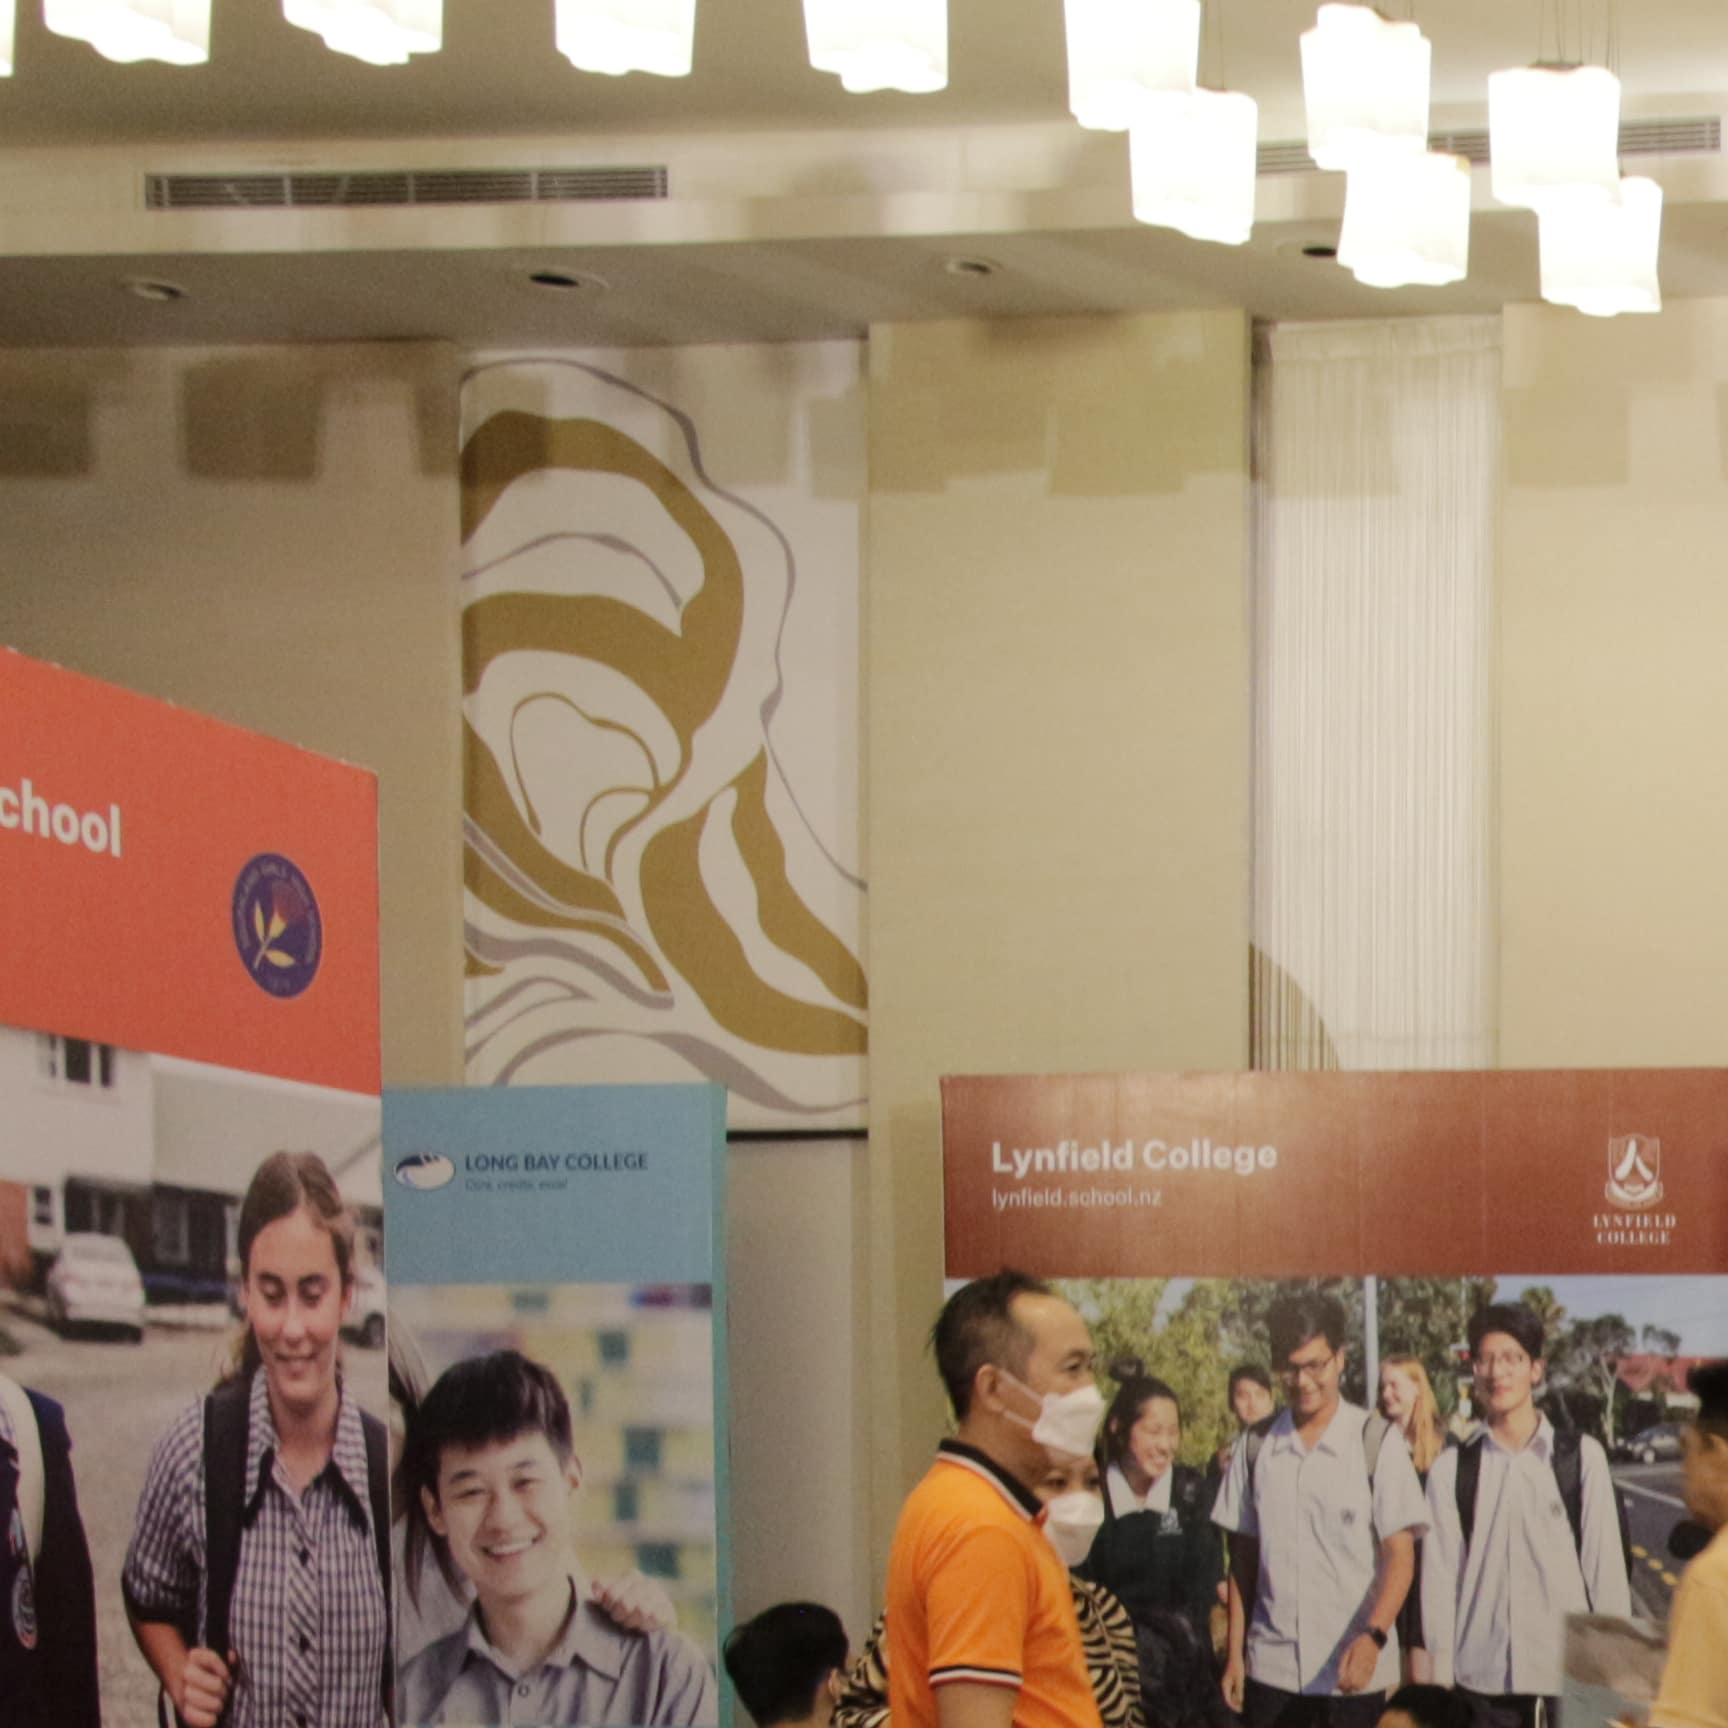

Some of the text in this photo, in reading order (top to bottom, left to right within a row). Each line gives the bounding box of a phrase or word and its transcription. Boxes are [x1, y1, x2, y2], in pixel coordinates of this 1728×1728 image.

[465, 1152, 649, 1172] LONG BAY COLLEGE
[992, 1137, 1278, 1179] Lynfield College
[992, 1187, 1162, 1211] lynfield.school.nz
[1593, 1213, 1677, 1229] LYNFIELD
[1597, 1230, 1671, 1246] COLLEGE
